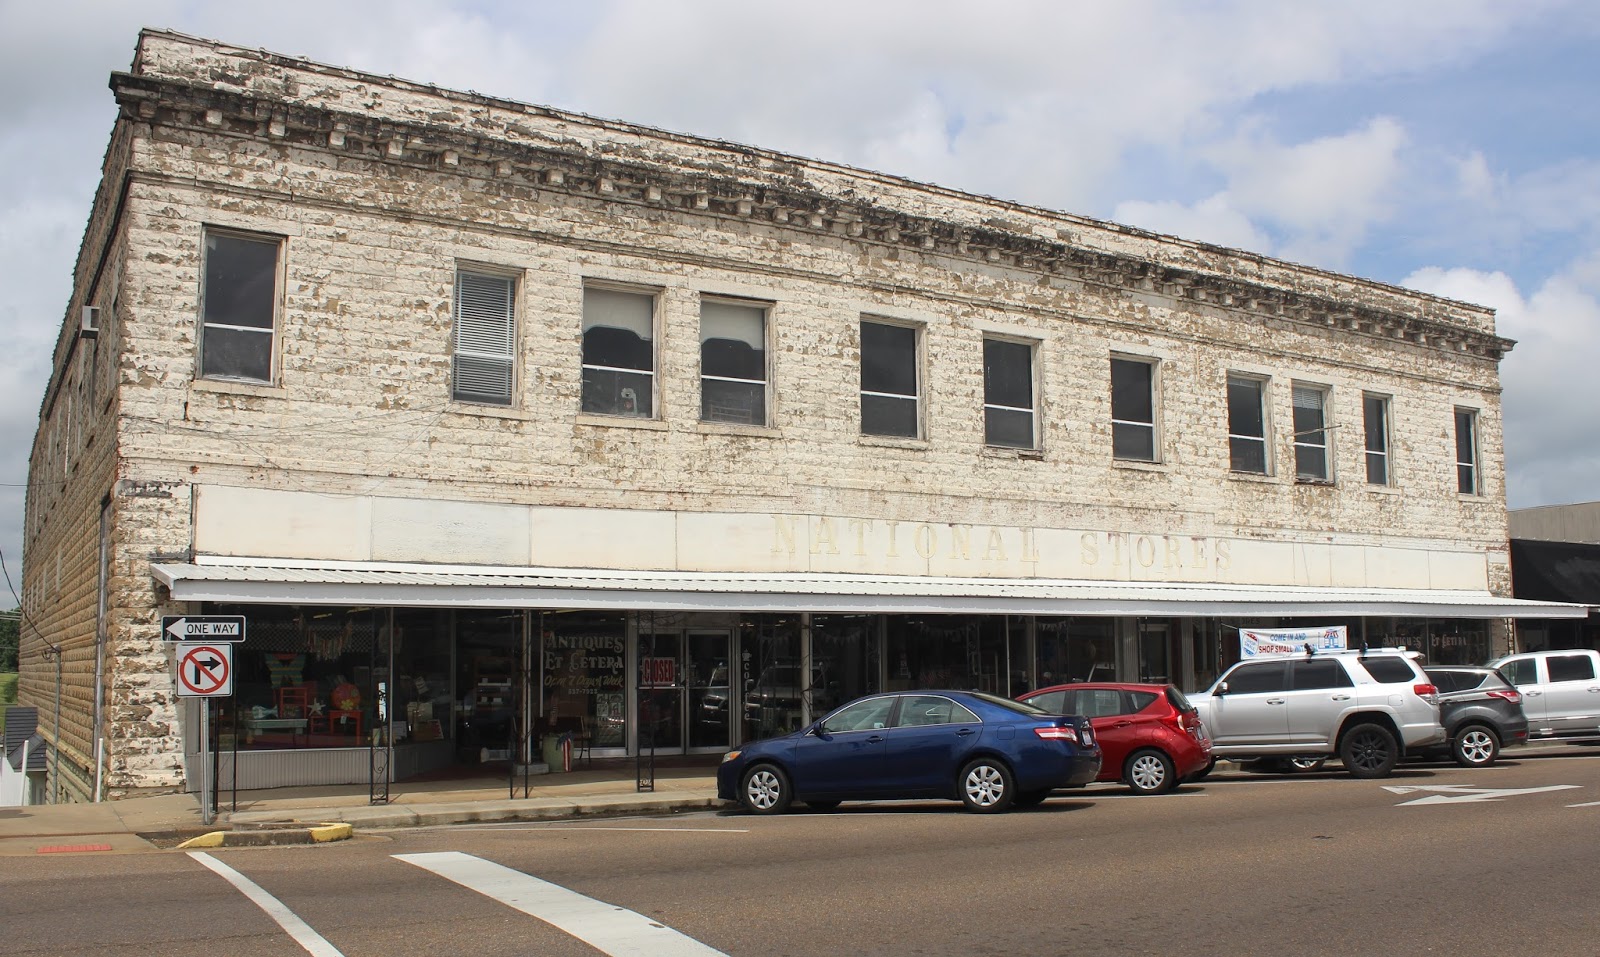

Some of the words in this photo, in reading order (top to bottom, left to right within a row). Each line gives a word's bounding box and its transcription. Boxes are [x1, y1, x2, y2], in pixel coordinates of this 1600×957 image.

[771, 514, 1040, 564] NATIONAL
[1080, 530, 1232, 571] STORES
[187, 623, 209, 634] ONE
[213, 623, 235, 634] WAY
[1270, 633, 1287, 642] COME
[1287, 633, 1294, 641] IN
[1295, 632, 1306, 641] AND
[543, 631, 624, 653] ANTIQUES
[1258, 645, 1274, 654] SHOP
[1275, 644, 1293, 653] SMALL
[544, 651, 563, 670] ET
[569, 652, 624, 674] CETERA
[644, 659, 674, 682] COSED
